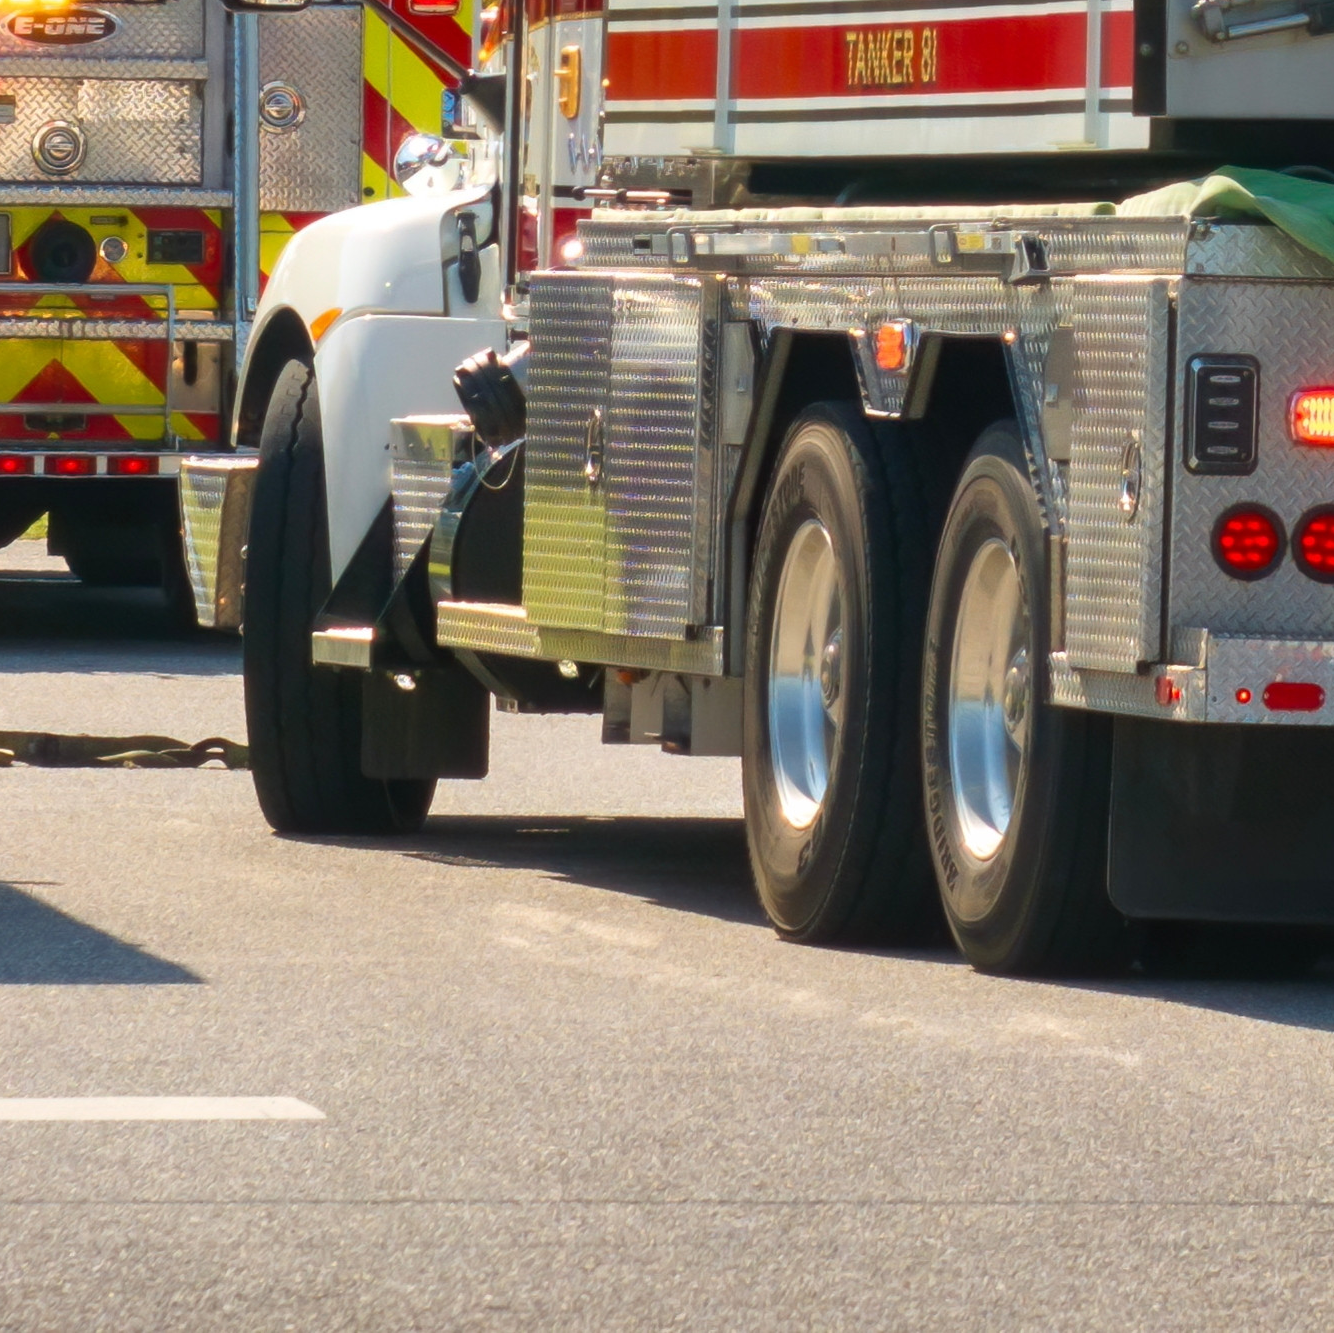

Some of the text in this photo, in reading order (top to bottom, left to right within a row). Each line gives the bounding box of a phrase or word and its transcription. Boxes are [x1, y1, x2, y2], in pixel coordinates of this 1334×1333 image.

[14, 16, 106, 36] E-ONE
[846, 27, 937, 86] TANKER 81
